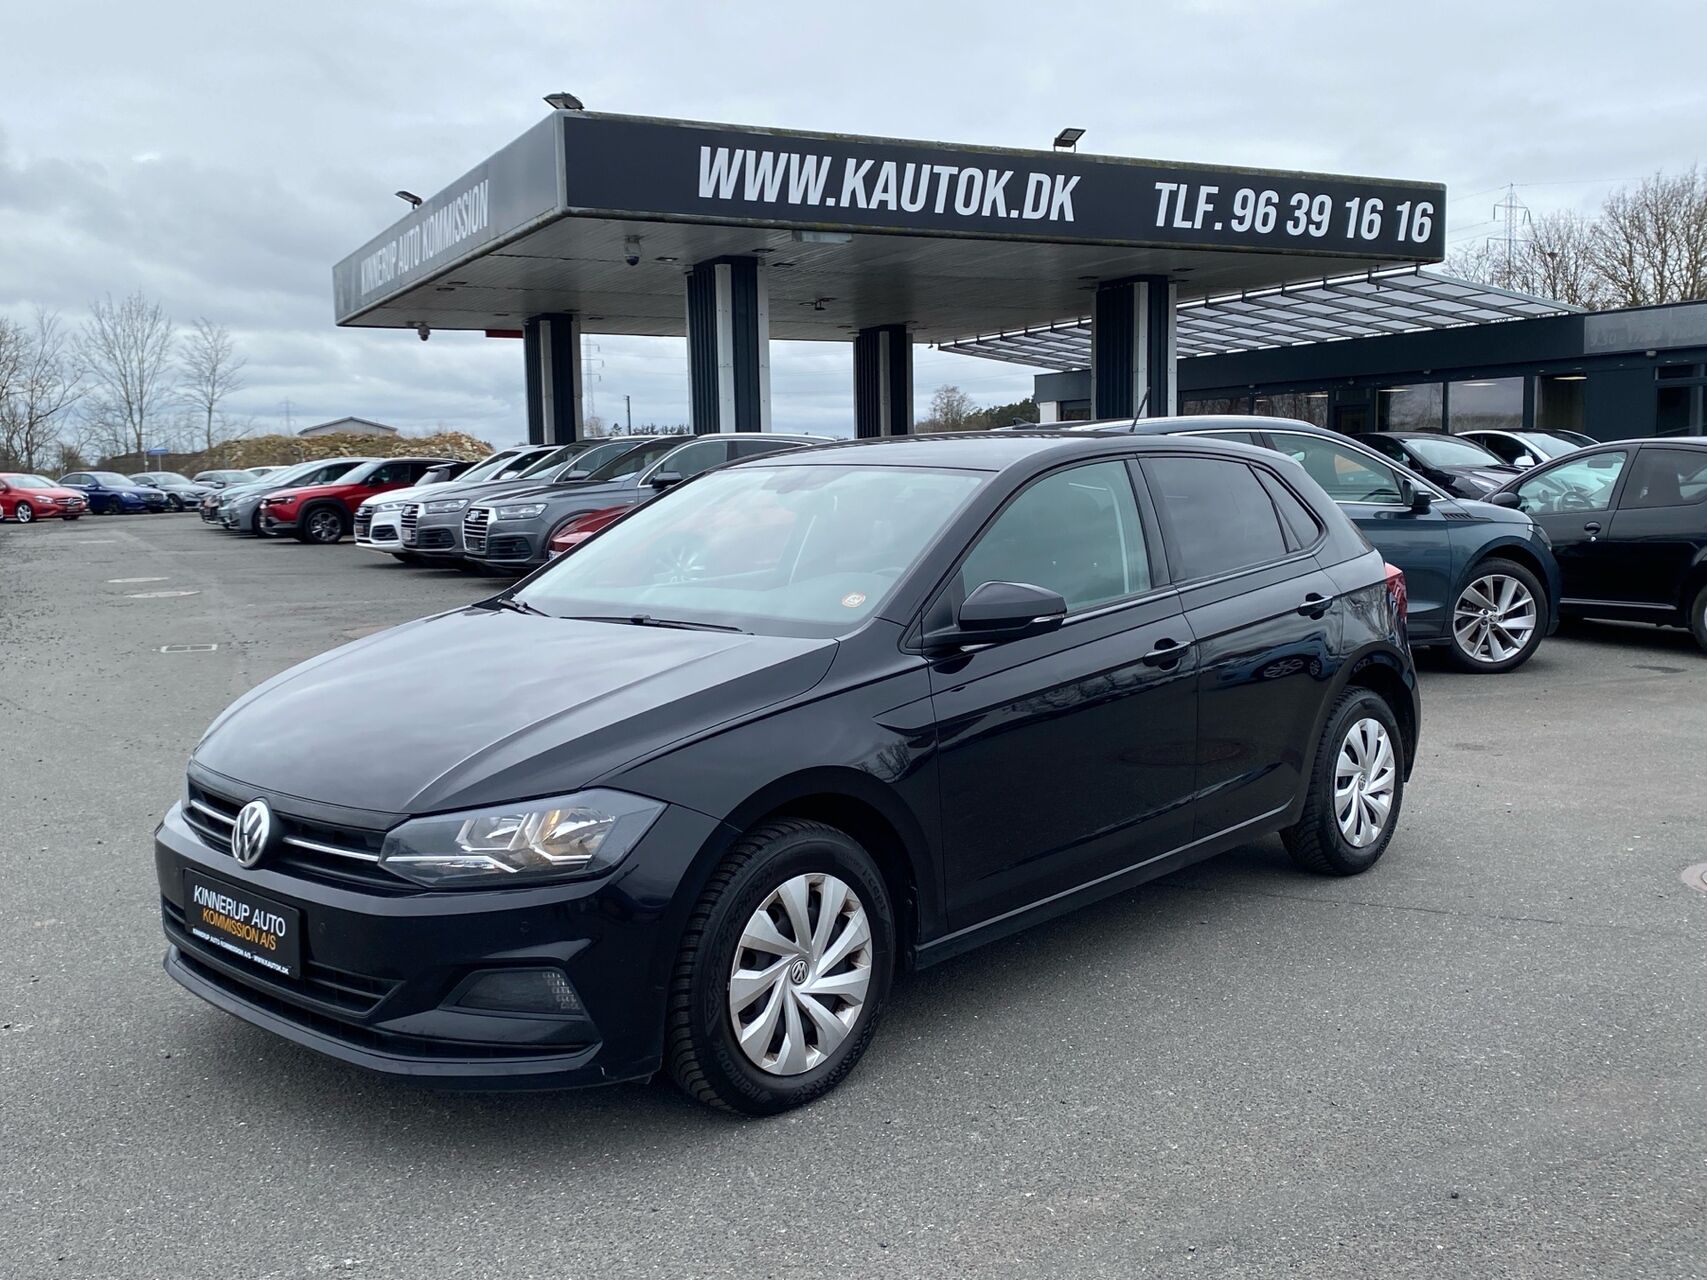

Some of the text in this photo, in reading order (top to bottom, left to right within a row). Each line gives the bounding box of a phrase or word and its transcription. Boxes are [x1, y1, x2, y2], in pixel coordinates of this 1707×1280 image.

[699, 146, 1081, 222] WWW.KAUTOK.DK
[1155, 182, 1434, 243] TLF. 96 39 16 16
[398, 225, 420, 275] AUTO
[422, 179, 489, 263] KOMMISSION
[193, 885, 286, 937] KINNERUP AUTO
[203, 908, 259, 944] KOMMISSION
[260, 931, 276, 951] A/S
